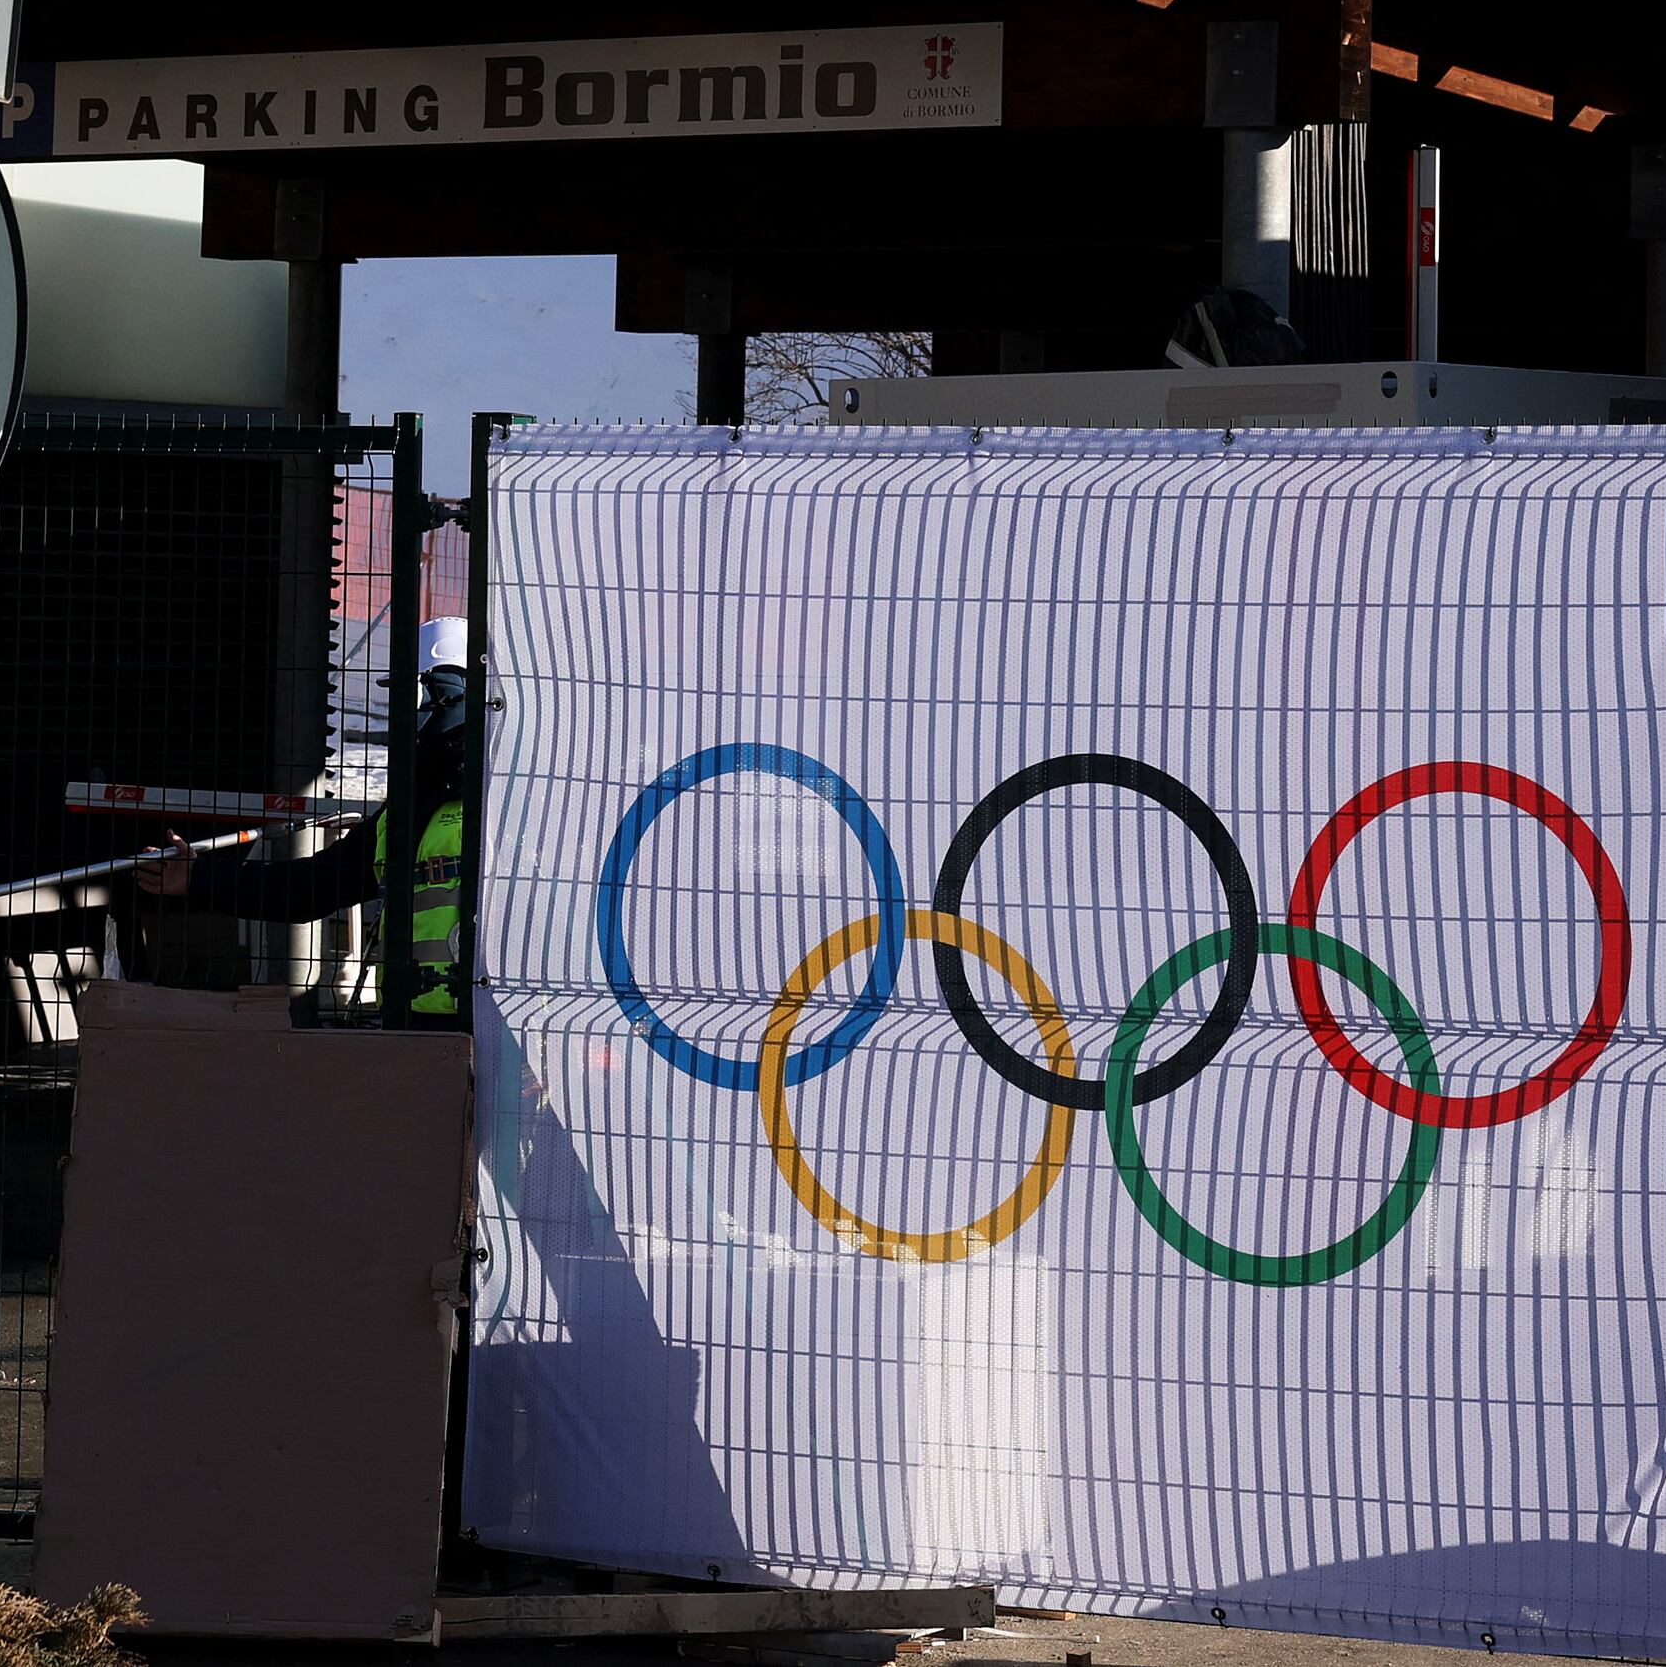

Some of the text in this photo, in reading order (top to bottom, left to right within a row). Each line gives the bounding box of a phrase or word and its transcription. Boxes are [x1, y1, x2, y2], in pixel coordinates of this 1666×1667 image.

[2, 43, 877, 142] P PARKING Bormio
[907, 86, 972, 100] COMUNE
[903, 104, 975, 118] di BORMIO
